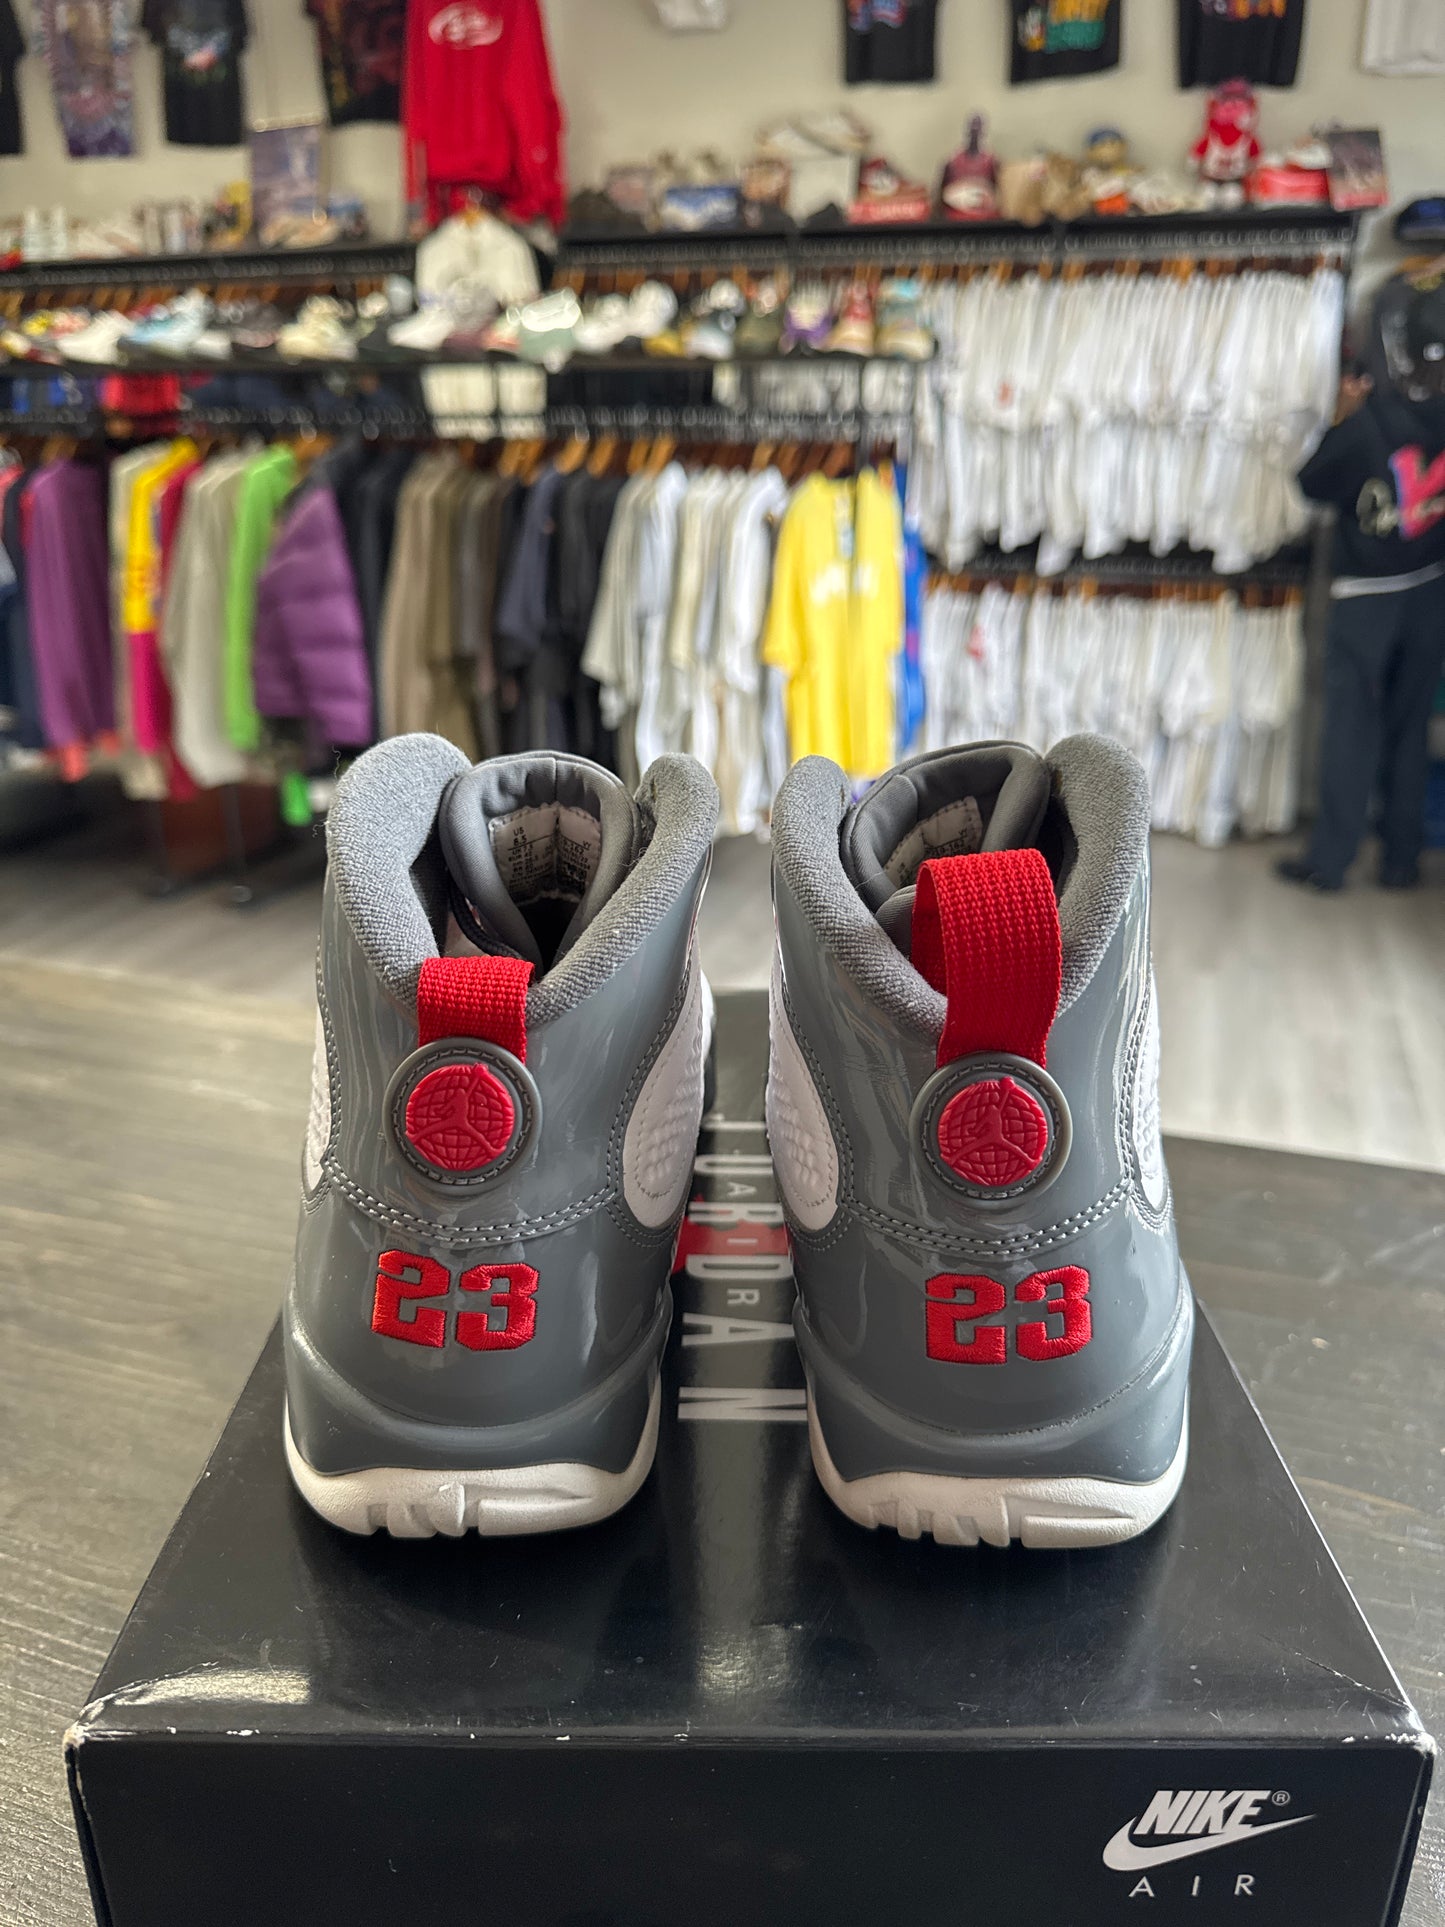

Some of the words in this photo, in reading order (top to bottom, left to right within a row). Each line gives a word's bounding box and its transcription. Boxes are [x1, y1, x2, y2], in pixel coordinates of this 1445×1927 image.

[513, 827, 524, 836] US
[513, 835, 527, 847] 8.5
[678, 1112, 808, 1422] JORDAN
[726, 1181, 760, 1306] AIR
[371, 1249, 540, 1351] 23
[925, 1265, 1093, 1365] 23
[1133, 1789, 1271, 1835] NIKE
[1128, 1874, 1256, 1898] AIR
